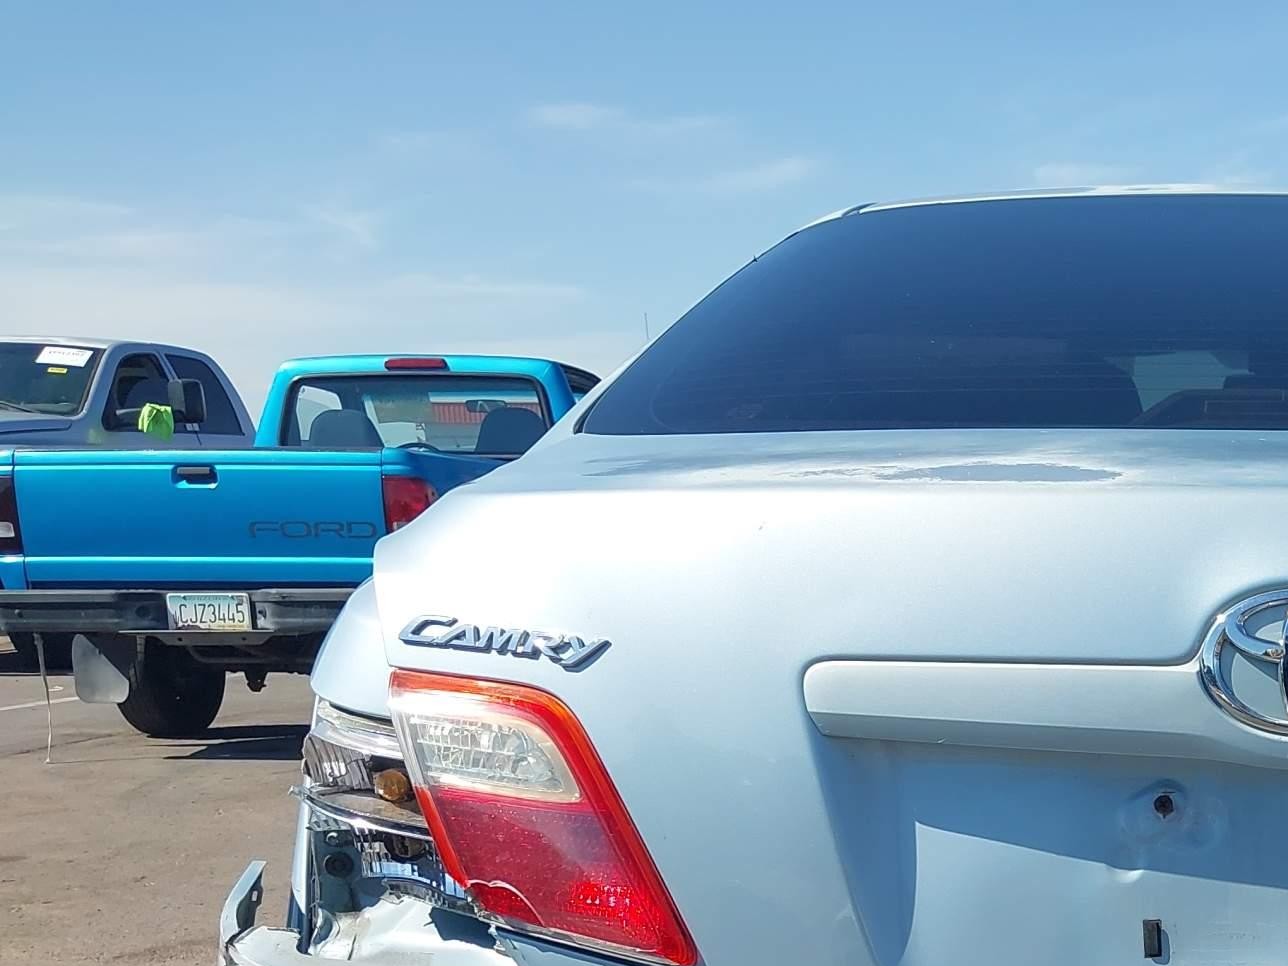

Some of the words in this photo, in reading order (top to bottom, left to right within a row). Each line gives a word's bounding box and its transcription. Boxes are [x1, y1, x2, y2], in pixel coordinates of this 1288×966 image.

[249, 520, 377, 539] FORD
[178, 603, 245, 624] CJZ3445
[398, 614, 613, 673] CAMRY
